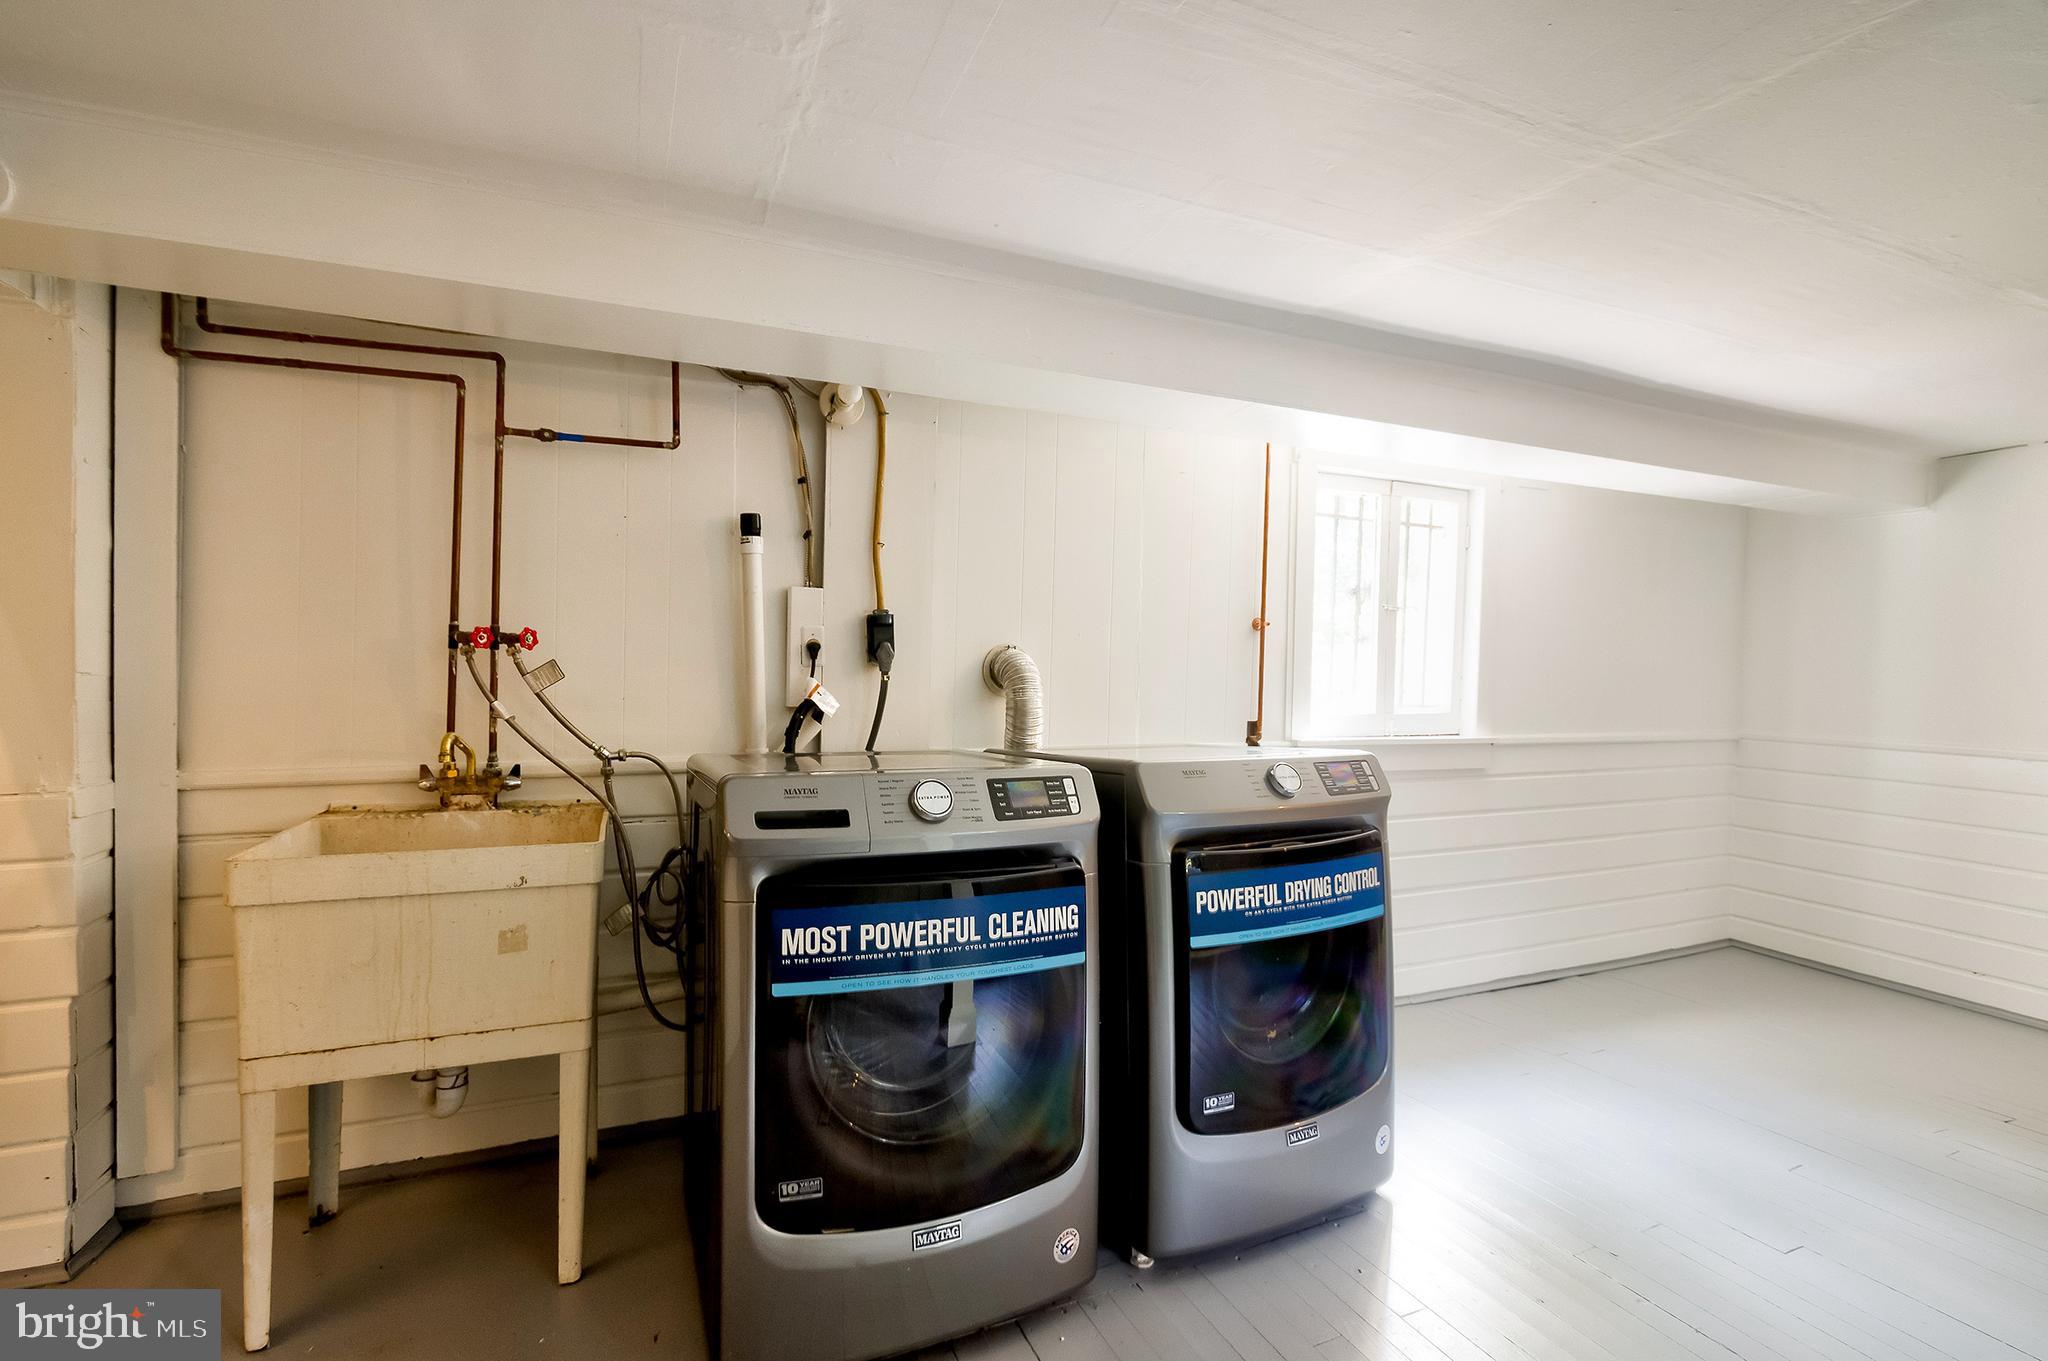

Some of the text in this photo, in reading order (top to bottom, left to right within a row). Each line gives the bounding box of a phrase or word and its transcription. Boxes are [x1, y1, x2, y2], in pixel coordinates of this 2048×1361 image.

[1196, 867, 1380, 914] POWERFUL DRYING CONTROL
[782, 904, 1079, 956] MOST POWERFUL CLEANING
[812, 955, 852, 964] INDUSTRY
[1032, 935, 1052, 943] POWER
[1054, 932, 1078, 940] BUTTON
[1206, 1098, 1218, 1108] 10
[1289, 1126, 1318, 1144] MAYTAG
[781, 1183, 798, 1196] 10
[916, 1225, 960, 1248] MAYTAG
